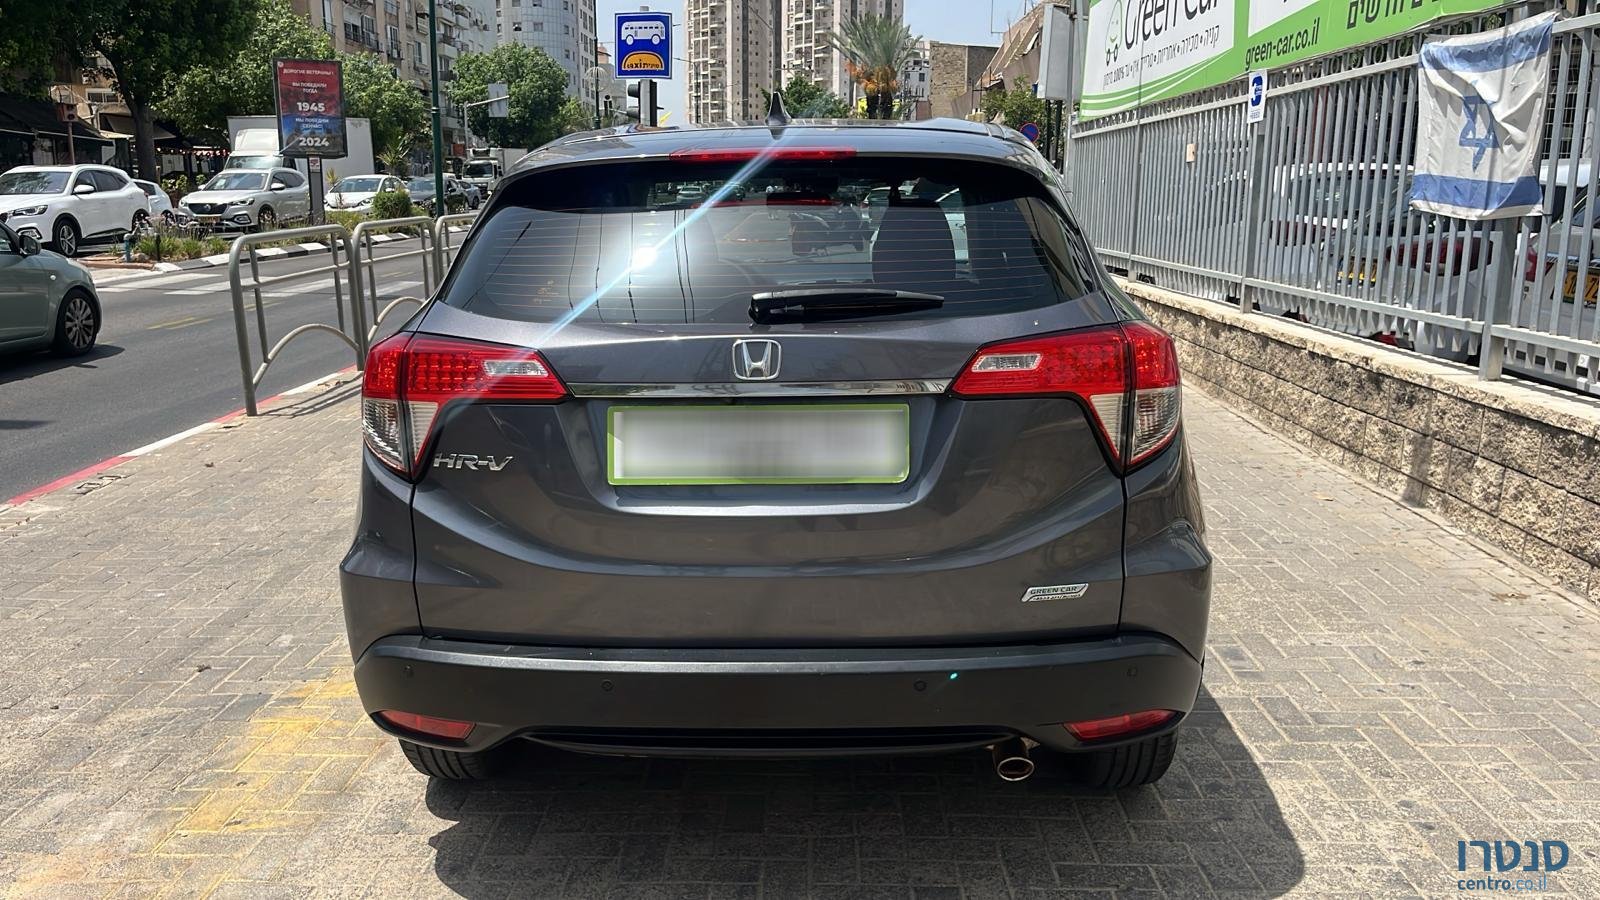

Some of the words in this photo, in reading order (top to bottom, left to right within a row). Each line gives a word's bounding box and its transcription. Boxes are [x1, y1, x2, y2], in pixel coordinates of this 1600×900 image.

[1180, 33, 1199, 56] מכירה
[1204, 25, 1219, 48] קניה
[1245, 17, 1320, 71] green-car.co.il
[627, 59, 642, 68] taxi
[297, 102, 325, 112] 1945
[299, 137, 330, 146] 2024
[433, 453, 513, 471] HR-V
